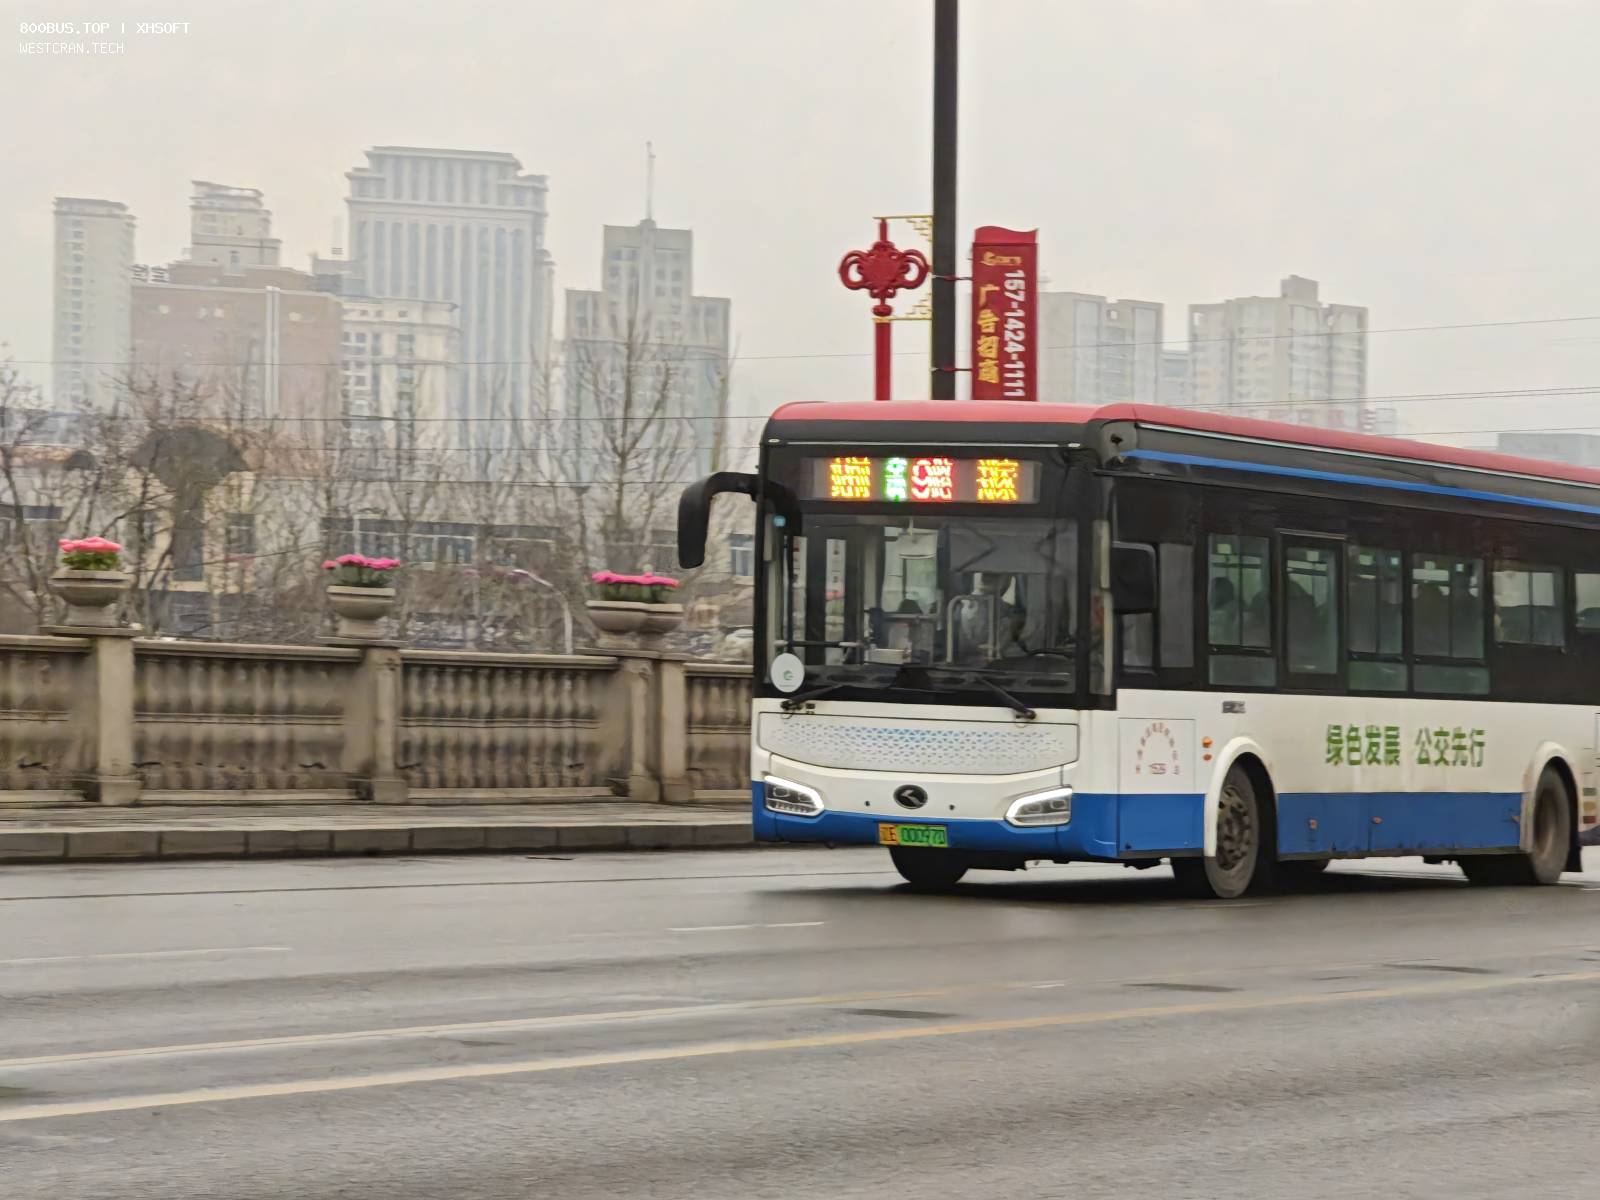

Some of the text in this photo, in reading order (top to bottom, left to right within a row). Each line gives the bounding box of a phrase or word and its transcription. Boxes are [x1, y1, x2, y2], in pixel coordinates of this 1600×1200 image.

[1325, 723, 1486, 768] 绿色发展 公交先行
